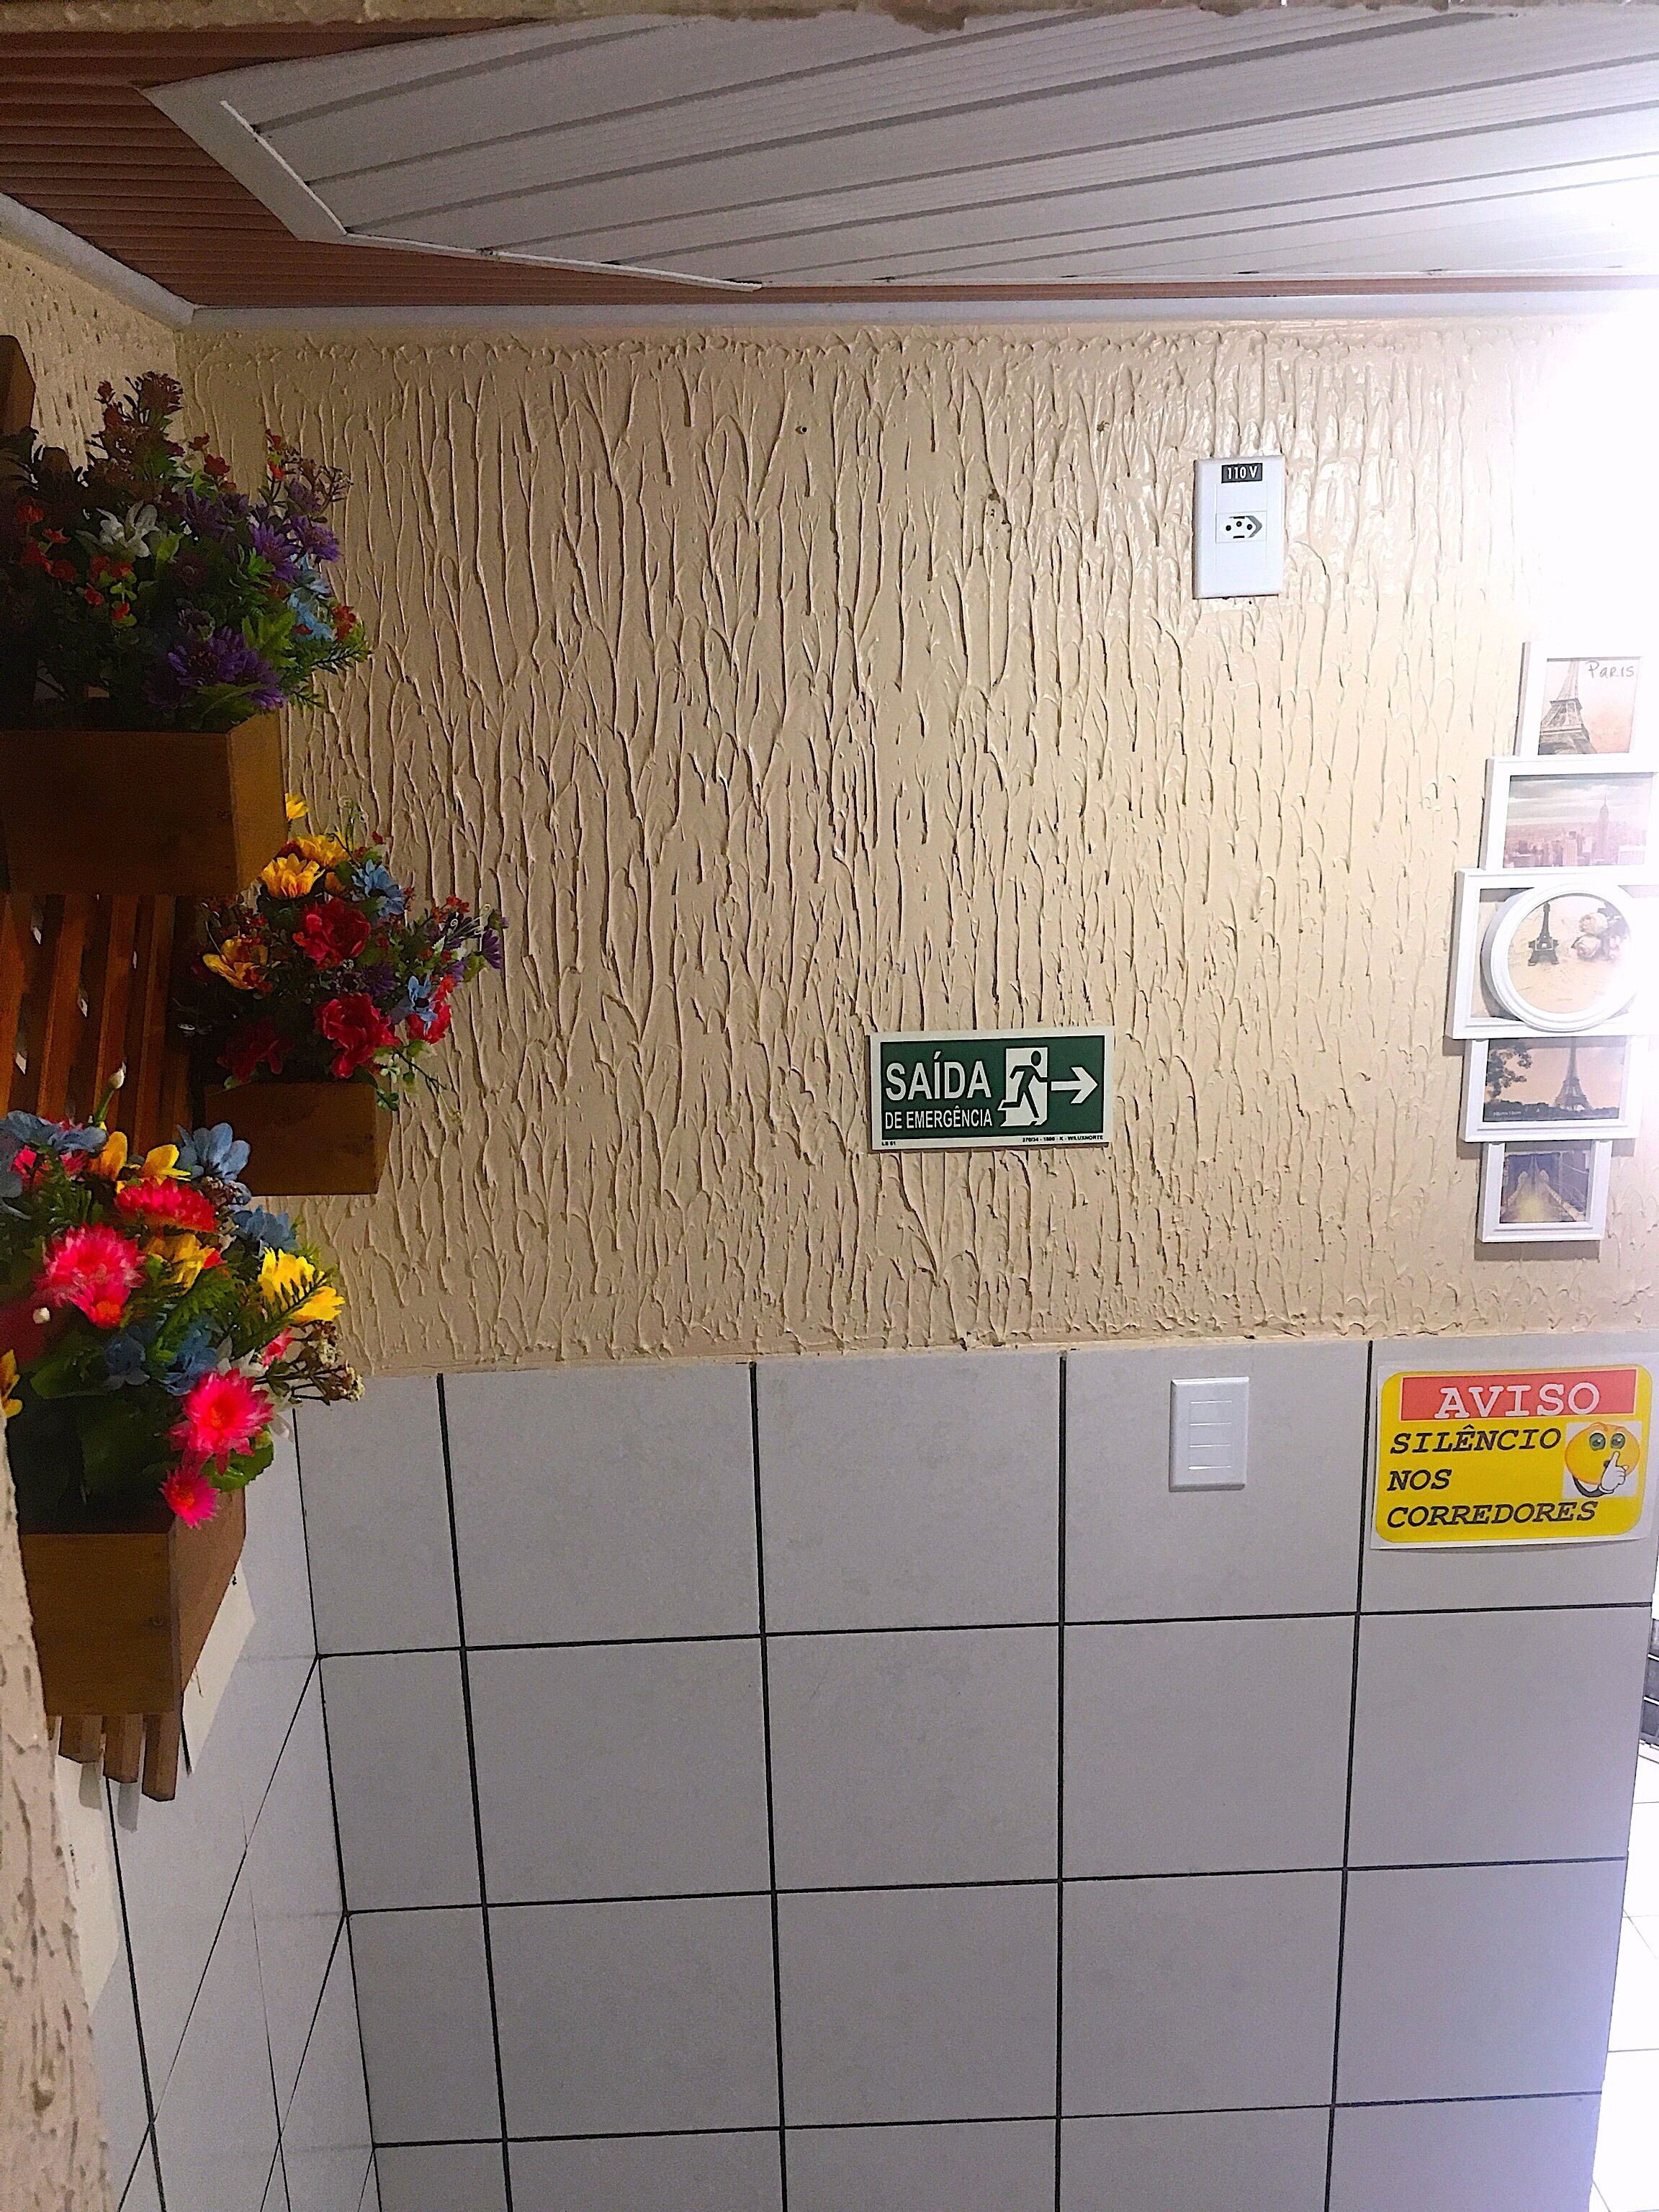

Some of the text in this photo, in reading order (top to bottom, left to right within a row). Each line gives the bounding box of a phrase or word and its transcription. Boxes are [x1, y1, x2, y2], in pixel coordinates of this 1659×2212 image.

[885, 1051, 992, 1101] SAÍDA
[885, 1106, 993, 1130] DE EMERGÊNCIA
[1434, 1382, 1600, 1419] AVISO
[1390, 1424, 1561, 1455] SILÊNCIO
[1386, 1469, 1452, 1491] NOS
[1387, 1501, 1599, 1528] CORREDORES
